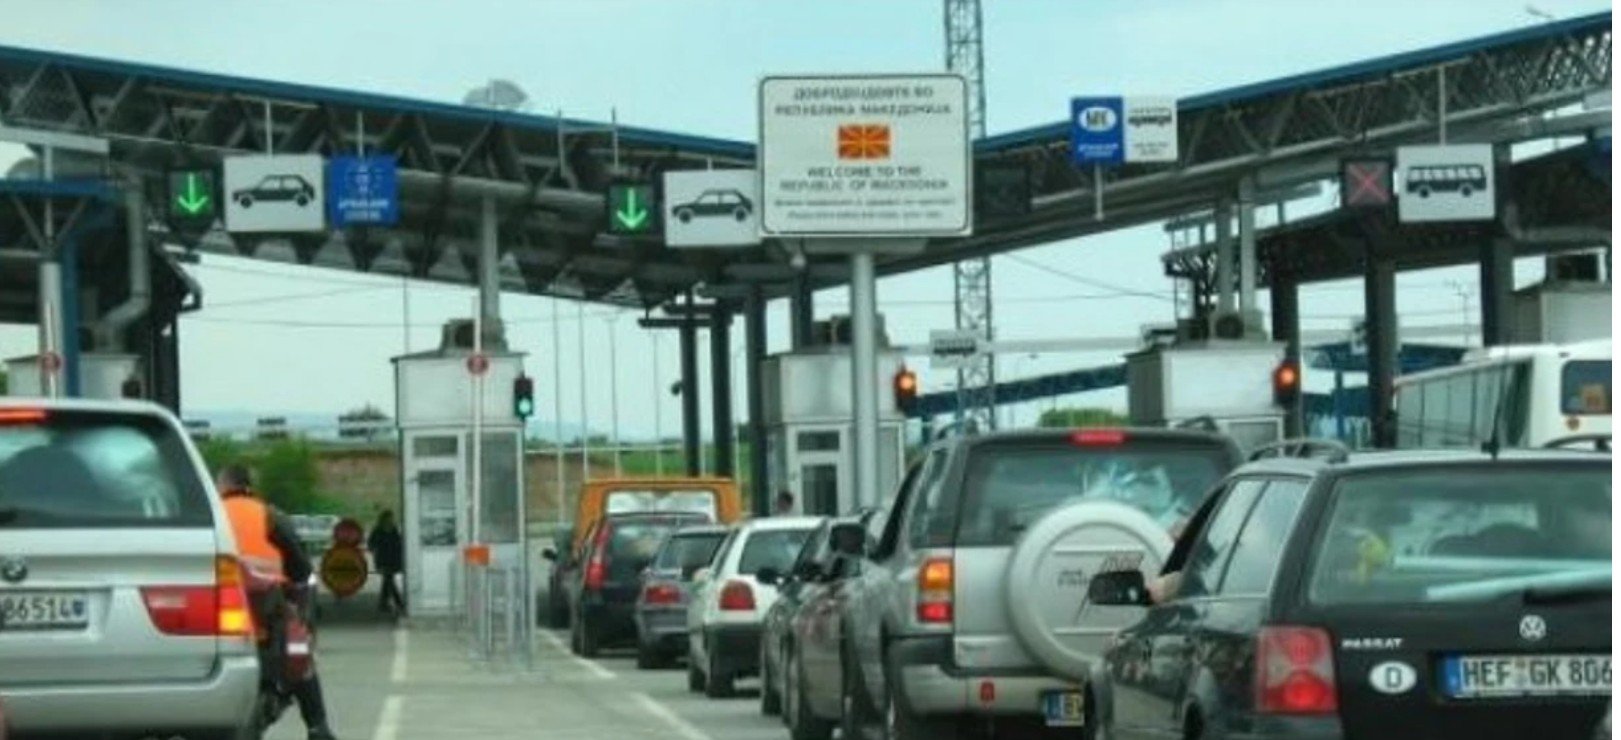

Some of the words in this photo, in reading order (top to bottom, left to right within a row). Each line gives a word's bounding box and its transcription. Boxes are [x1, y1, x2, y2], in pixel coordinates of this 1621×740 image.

[808, 166, 871, 177] WELCOME
[1386, 667, 1402, 688] D
[1463, 660, 1511, 687] HEF
[1530, 660, 1562, 686] GK
